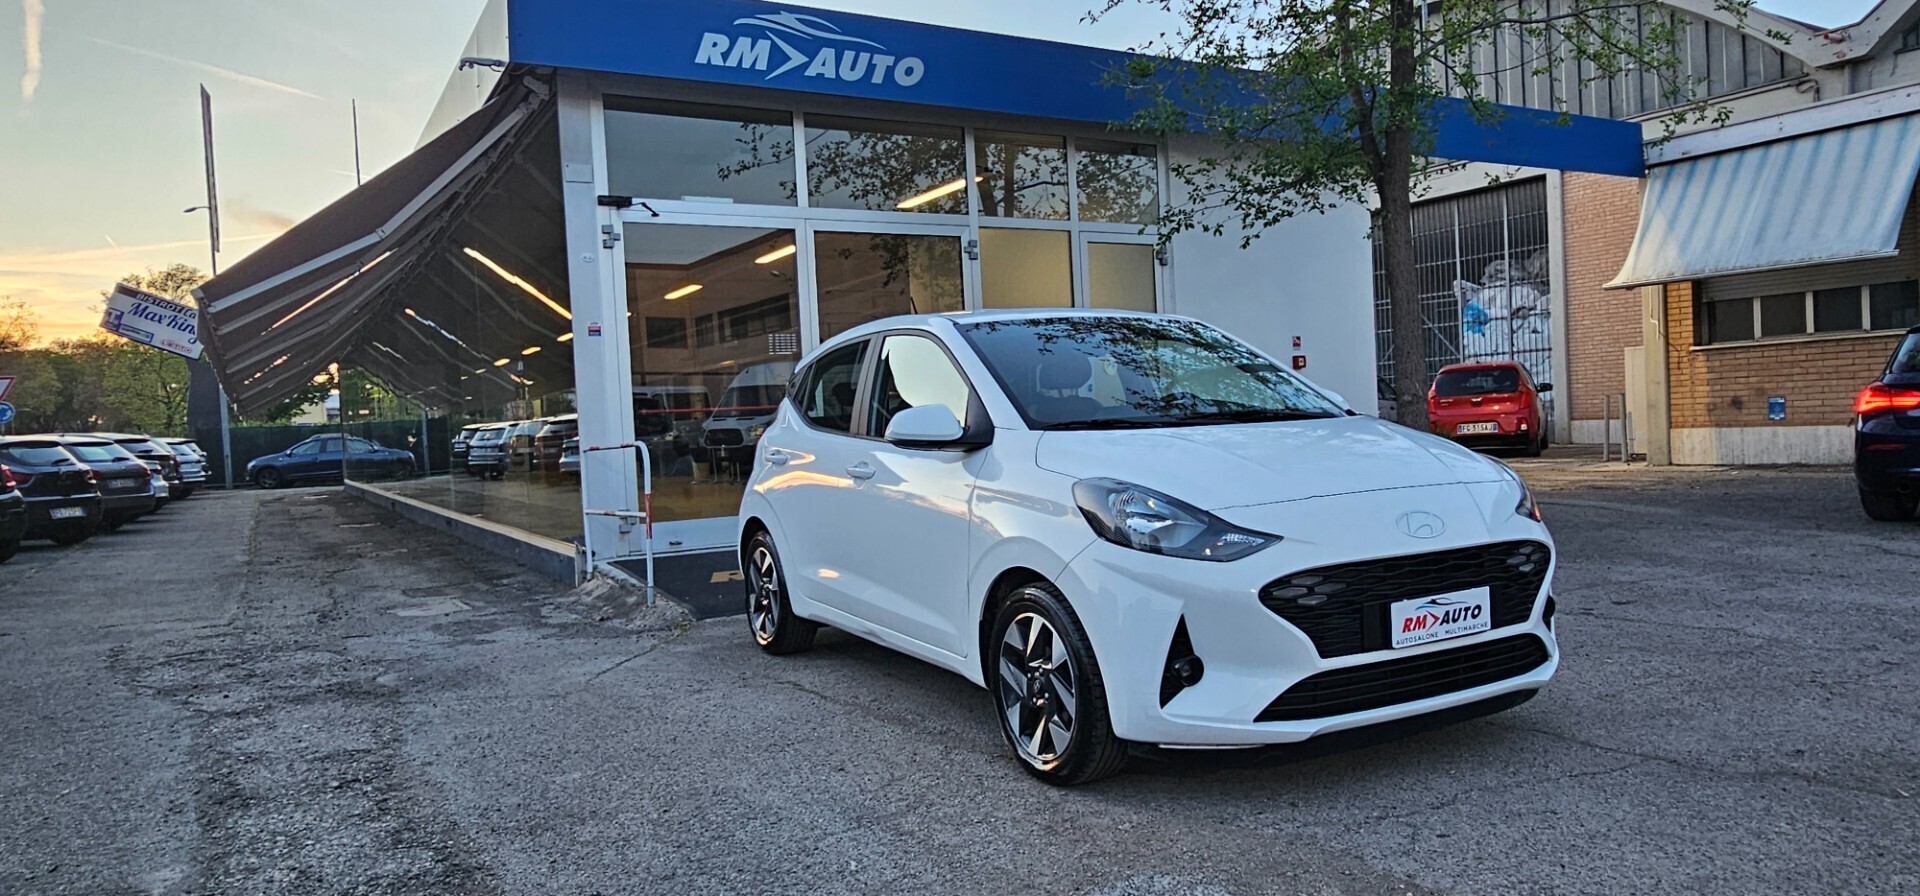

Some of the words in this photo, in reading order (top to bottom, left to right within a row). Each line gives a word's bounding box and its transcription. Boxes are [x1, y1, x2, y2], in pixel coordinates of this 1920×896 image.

[136, 293, 181, 315] BISTROT
[1396, 631, 1439, 646] AUTOSALONE
[1444, 621, 1489, 636] MULTIMARCHE
